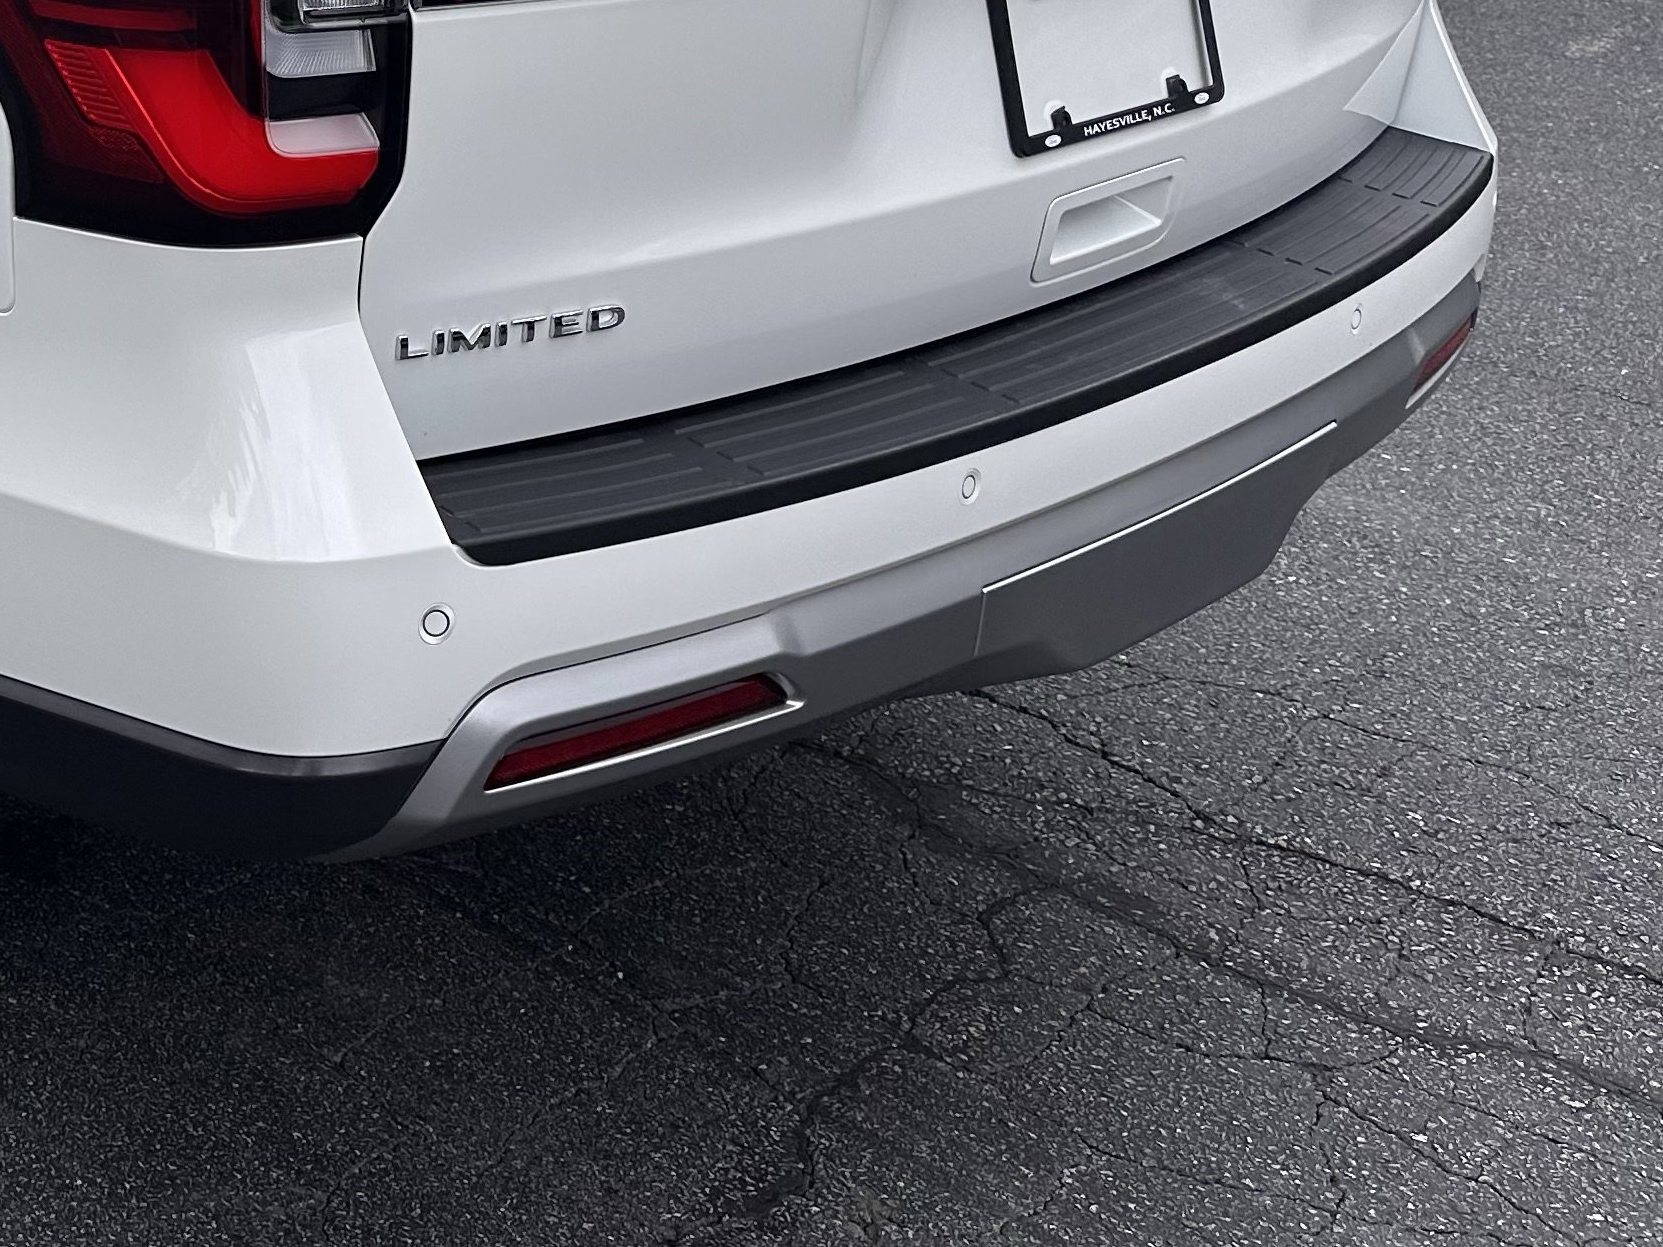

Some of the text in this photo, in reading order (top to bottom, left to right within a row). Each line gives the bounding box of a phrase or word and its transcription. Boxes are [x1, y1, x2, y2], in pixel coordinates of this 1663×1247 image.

[1083, 103, 1176, 137] HAYESVILLE, N.C.
[395, 304, 626, 360] LIMITED
